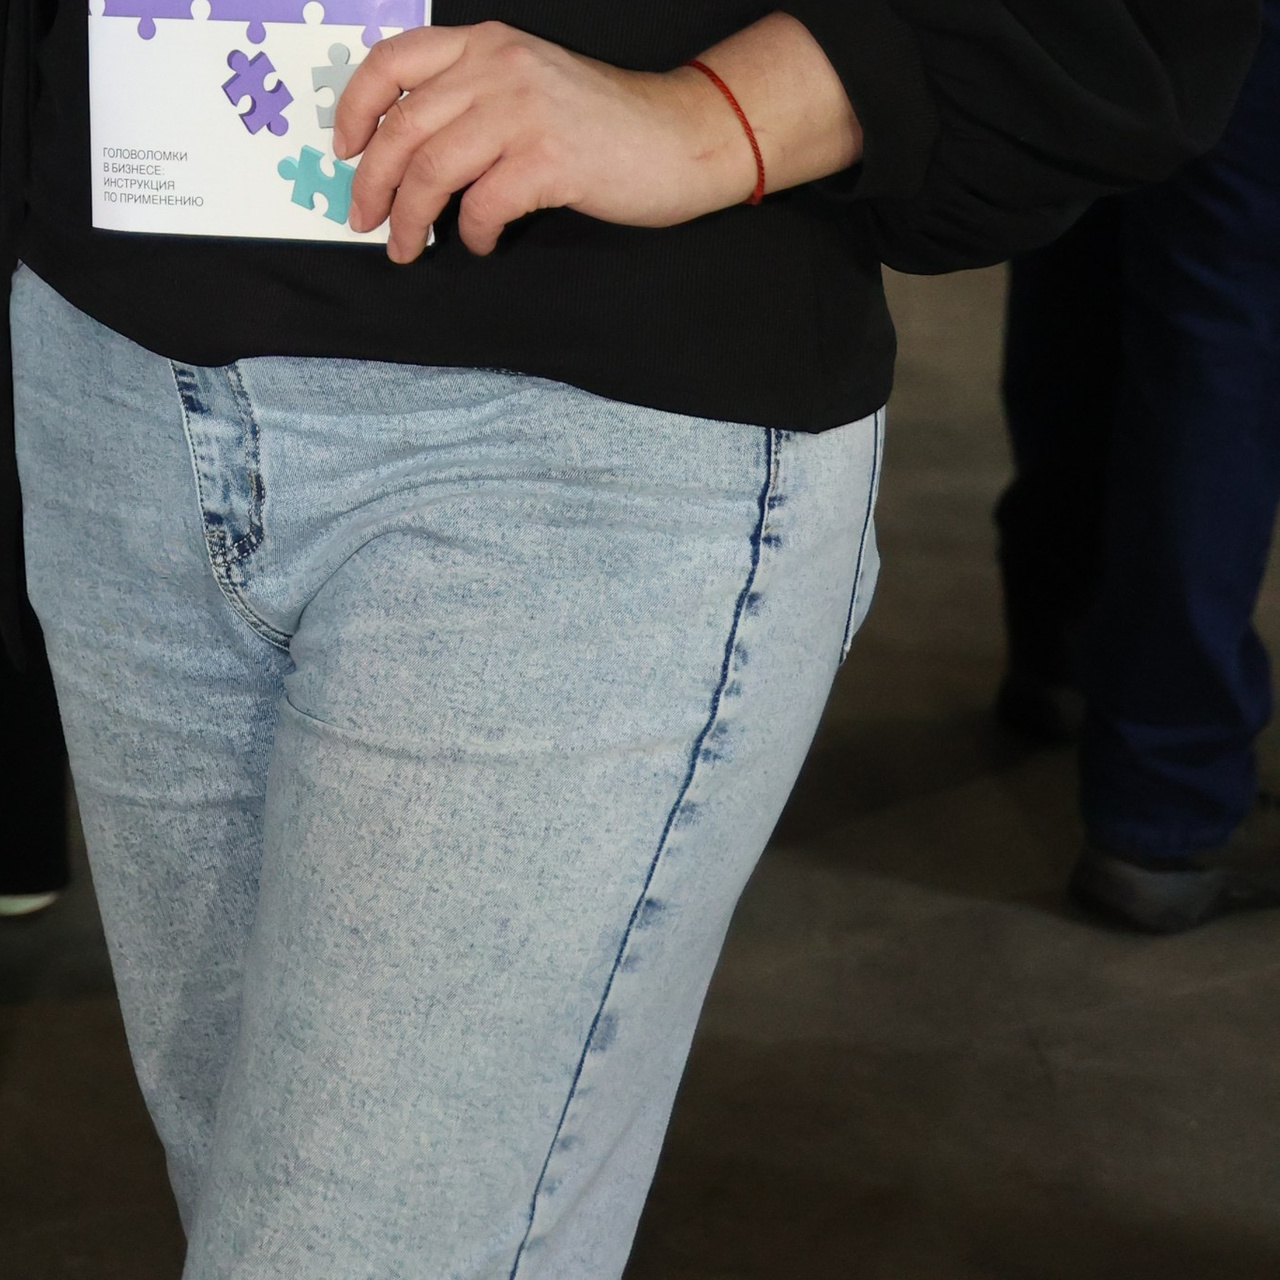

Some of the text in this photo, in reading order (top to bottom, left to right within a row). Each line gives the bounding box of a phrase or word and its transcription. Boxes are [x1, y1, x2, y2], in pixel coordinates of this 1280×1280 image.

[103, 147, 188, 161] ГОЛОВОЛОМКИ
[103, 162, 165, 175] В БИЗНЕСЕ:
[103, 177, 175, 191] ИНСТРУКЦИЯ
[104, 191, 204, 206] ПО ПРИМЕНЕНИЮ
